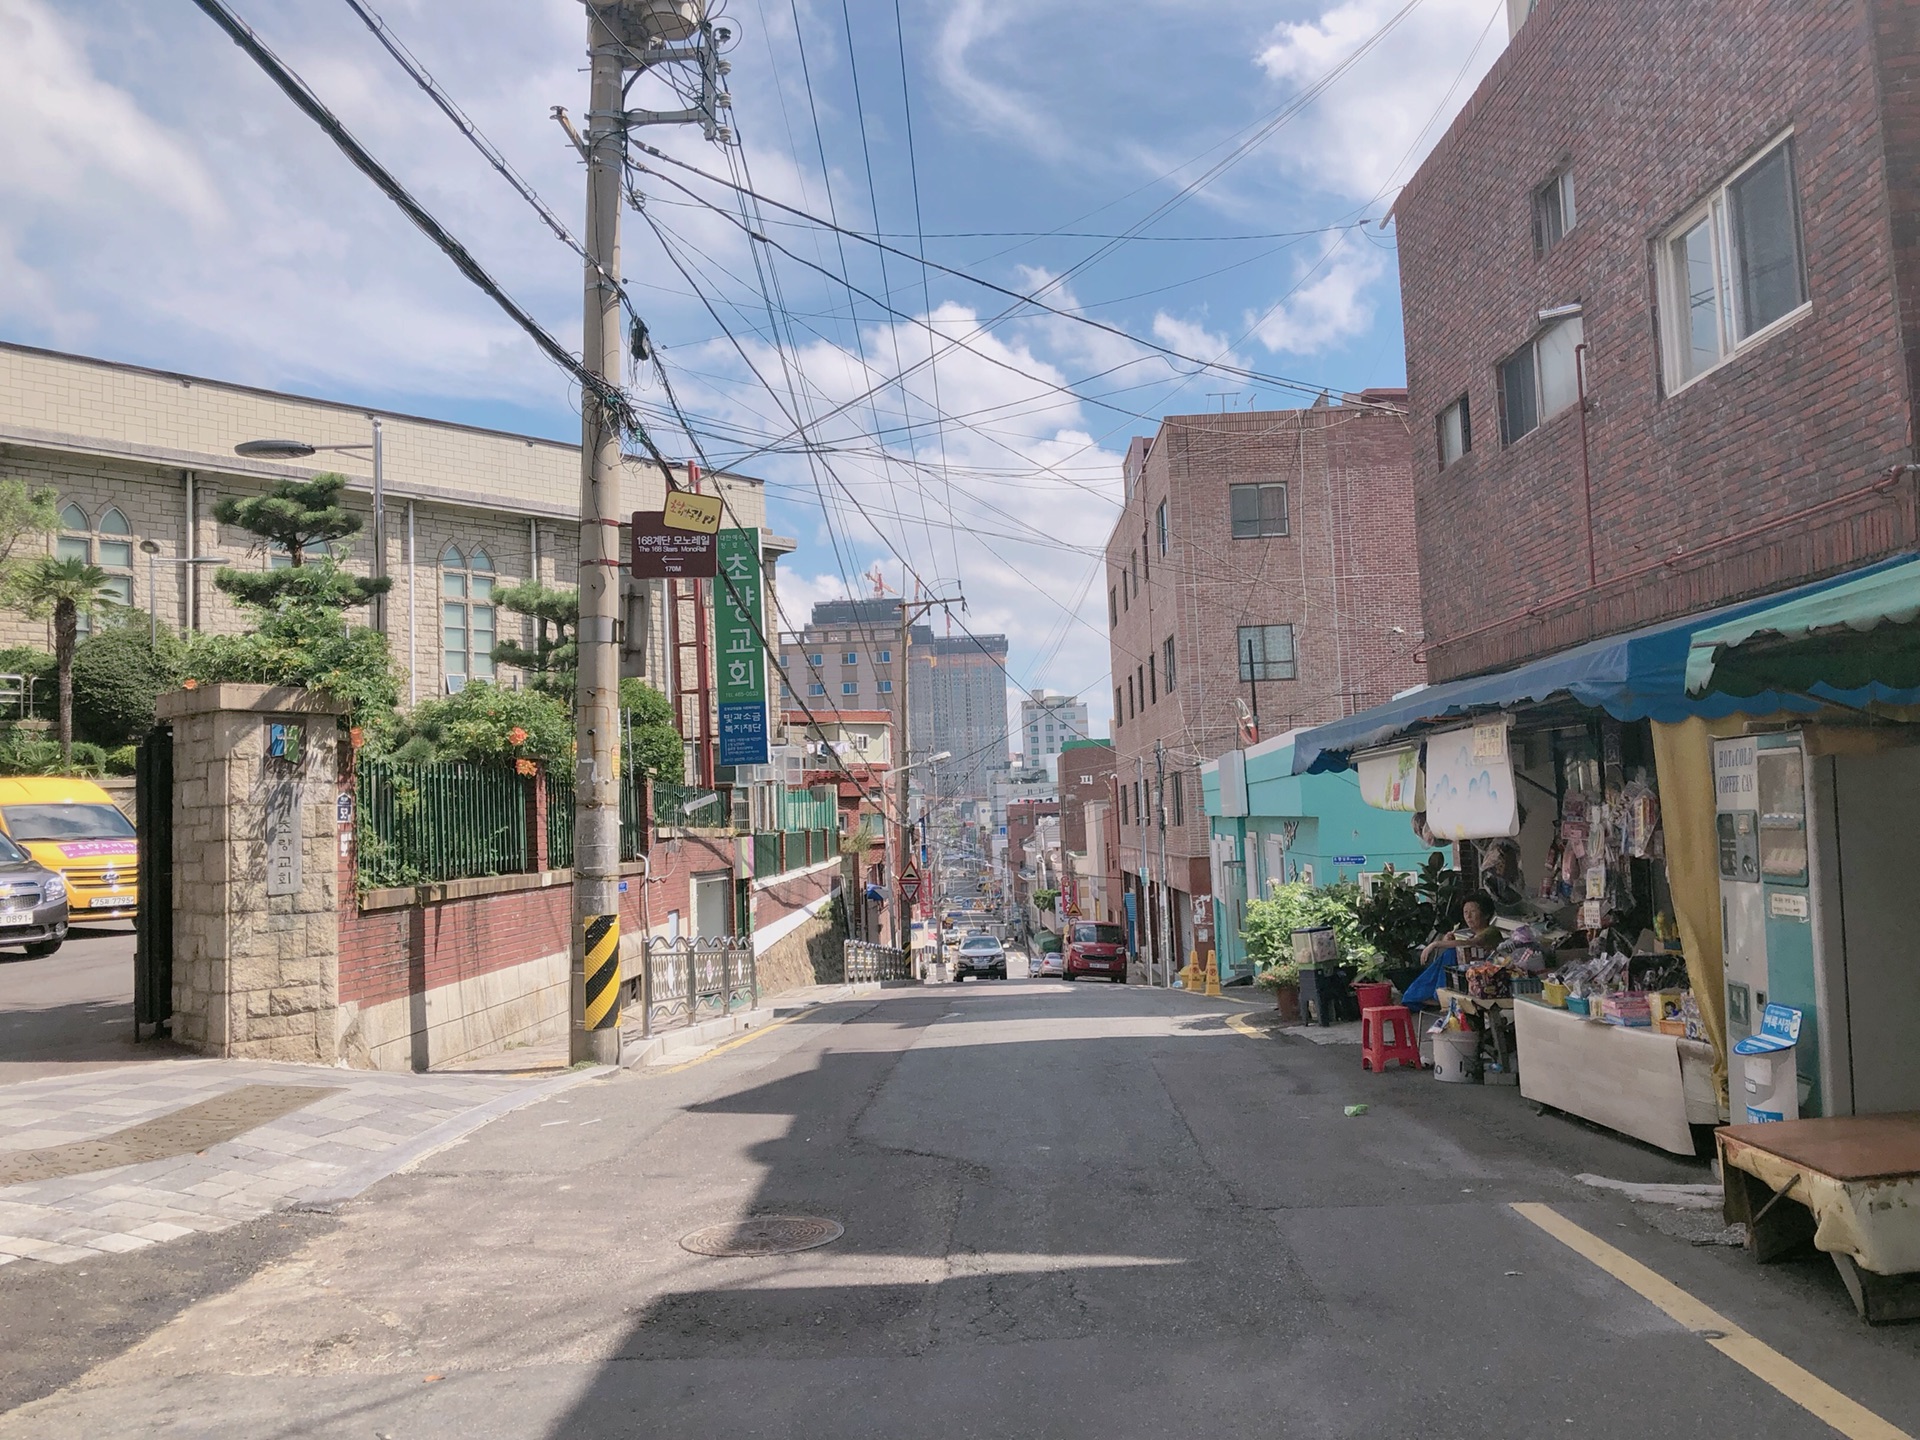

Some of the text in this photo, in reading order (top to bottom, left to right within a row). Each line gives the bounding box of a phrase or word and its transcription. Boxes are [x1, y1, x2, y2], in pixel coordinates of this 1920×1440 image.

[636, 535, 710, 546] 168계단 모노레일
[681, 545, 707, 553] MonoRail
[725, 553, 756, 690] 초량교회
[723, 712, 761, 724] 빛과소금
[724, 723, 762, 734] 복지재단
[278, 820, 292, 885] 초량교회
[6, 914, 28, 924] 0891
